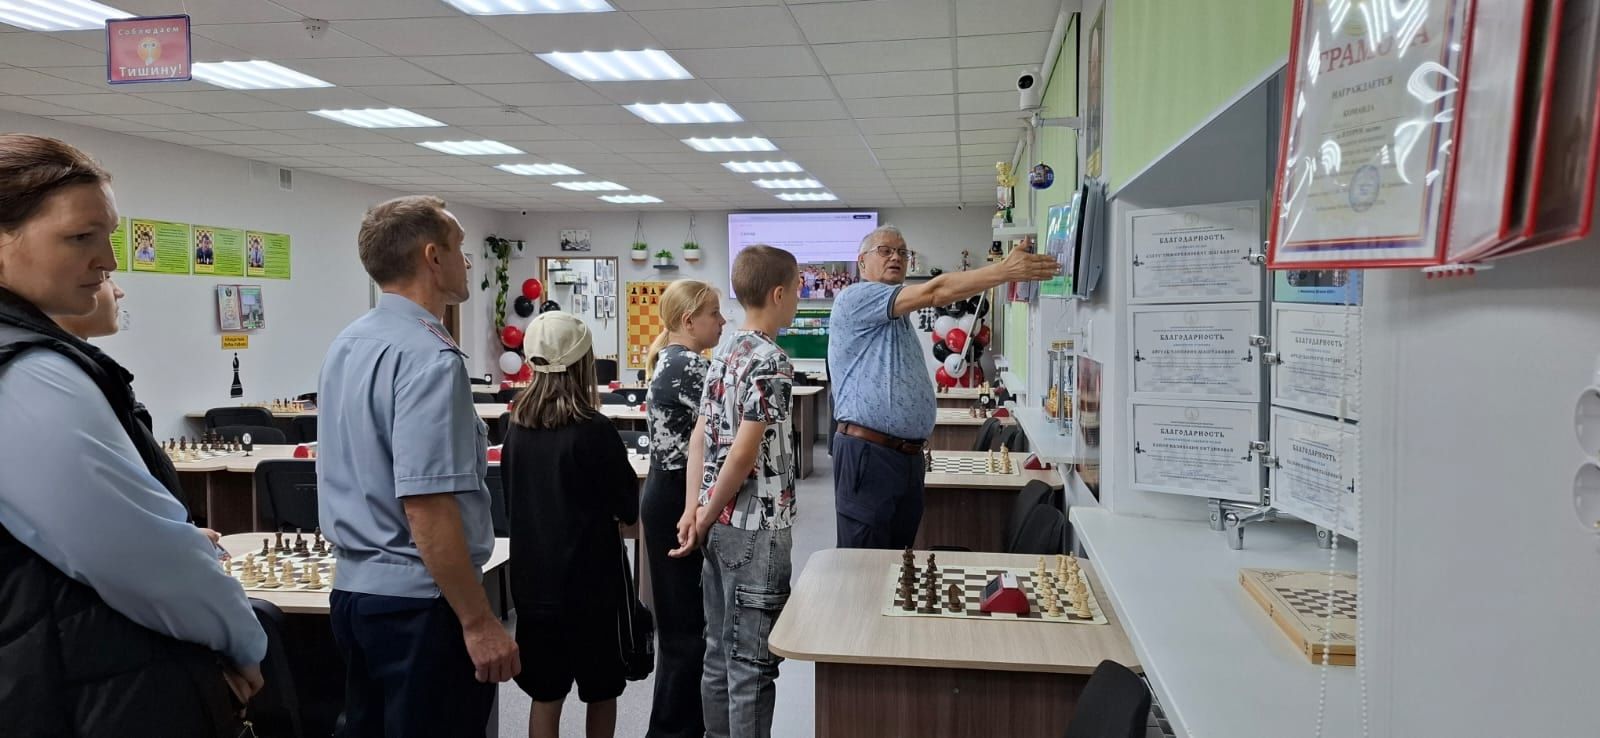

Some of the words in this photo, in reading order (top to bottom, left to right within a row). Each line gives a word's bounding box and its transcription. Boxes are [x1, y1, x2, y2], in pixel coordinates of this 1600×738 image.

[118, 25, 180, 36] Соблюдаем
[1317, 24, 1432, 76] ГРАМОА
[119, 63, 182, 78] Тишину!
[1159, 233, 1225, 244] БЛАГОДАРНОСТЬ
[1295, 336, 1343, 348] БЛАГОДАРНОСТЬ
[1159, 428, 1225, 438] БЛАГОДАРНОСТЬ
[1292, 443, 1337, 462] БЛАГОДАРНОСТЬ
